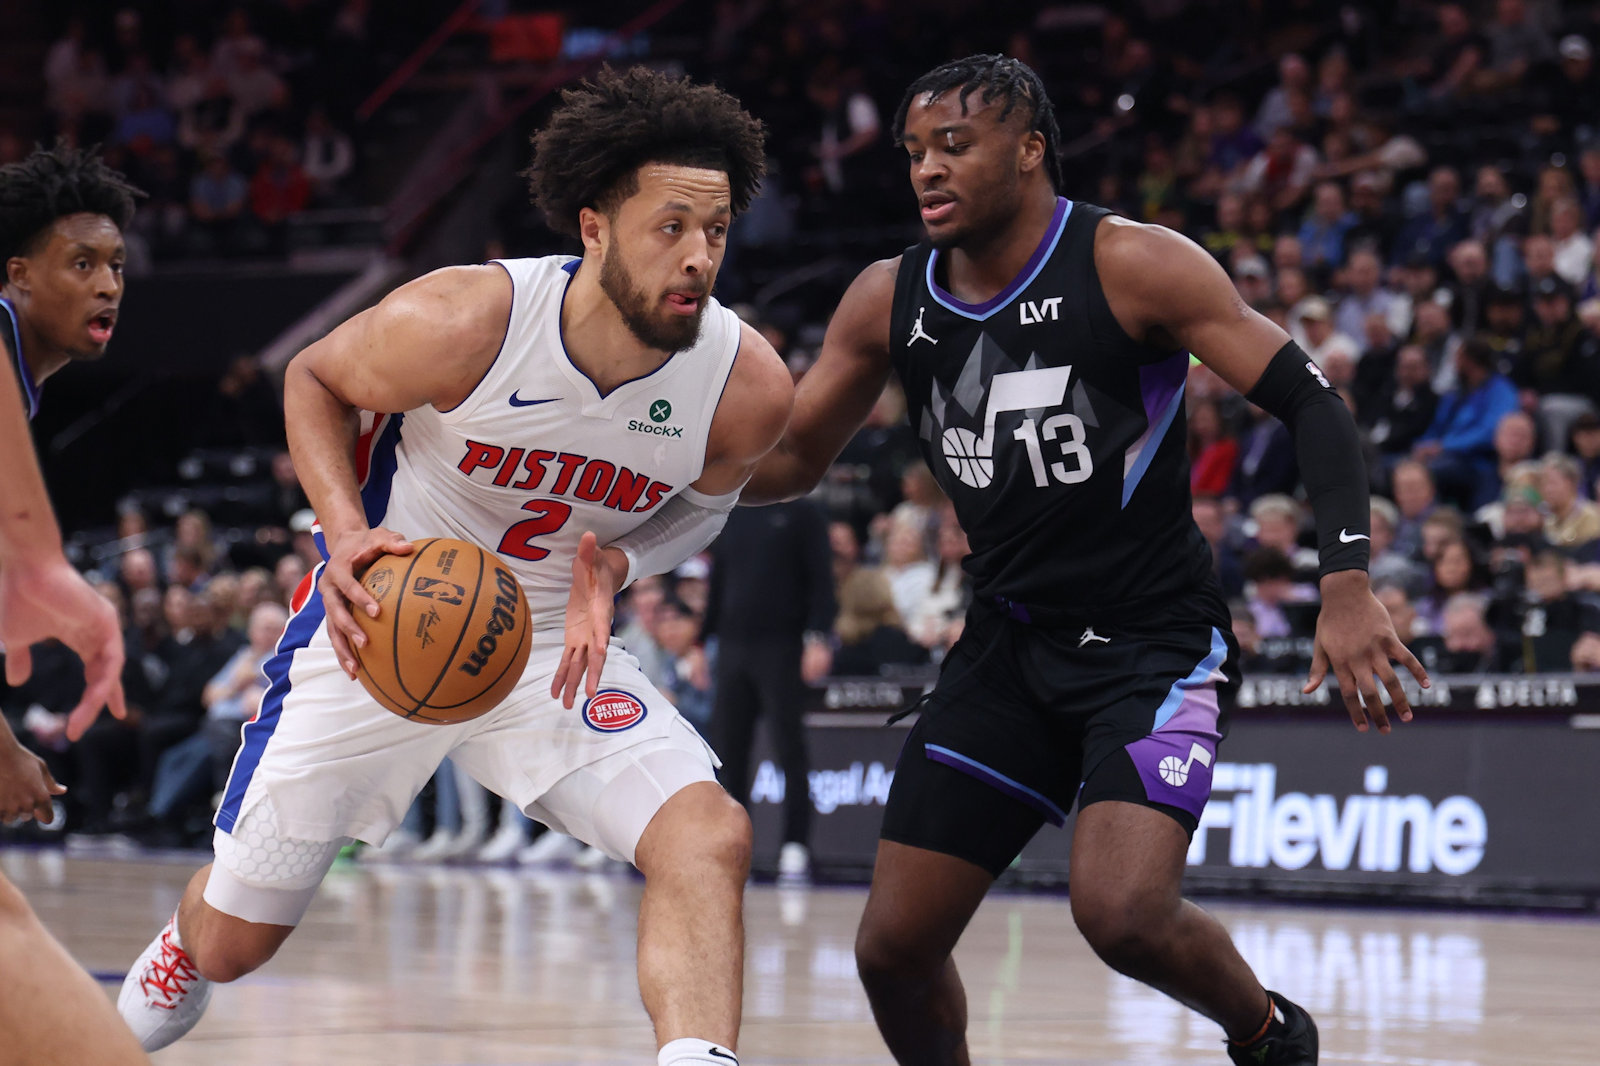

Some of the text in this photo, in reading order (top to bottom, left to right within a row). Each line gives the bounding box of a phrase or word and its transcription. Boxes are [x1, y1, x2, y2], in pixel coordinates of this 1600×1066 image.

[1019, 296, 1063, 325] LVT
[627, 419, 684, 438] StockX
[1012, 413, 1094, 488] 13
[457, 439, 674, 513] PISTONS
[496, 498, 573, 562] 2
[458, 566, 519, 677] Wilson
[594, 702, 633, 713] DETROIT
[596, 708, 636, 721] PISTONS
[1500, 679, 1578, 707] DELTA
[1186, 762, 1488, 876] Filevine
